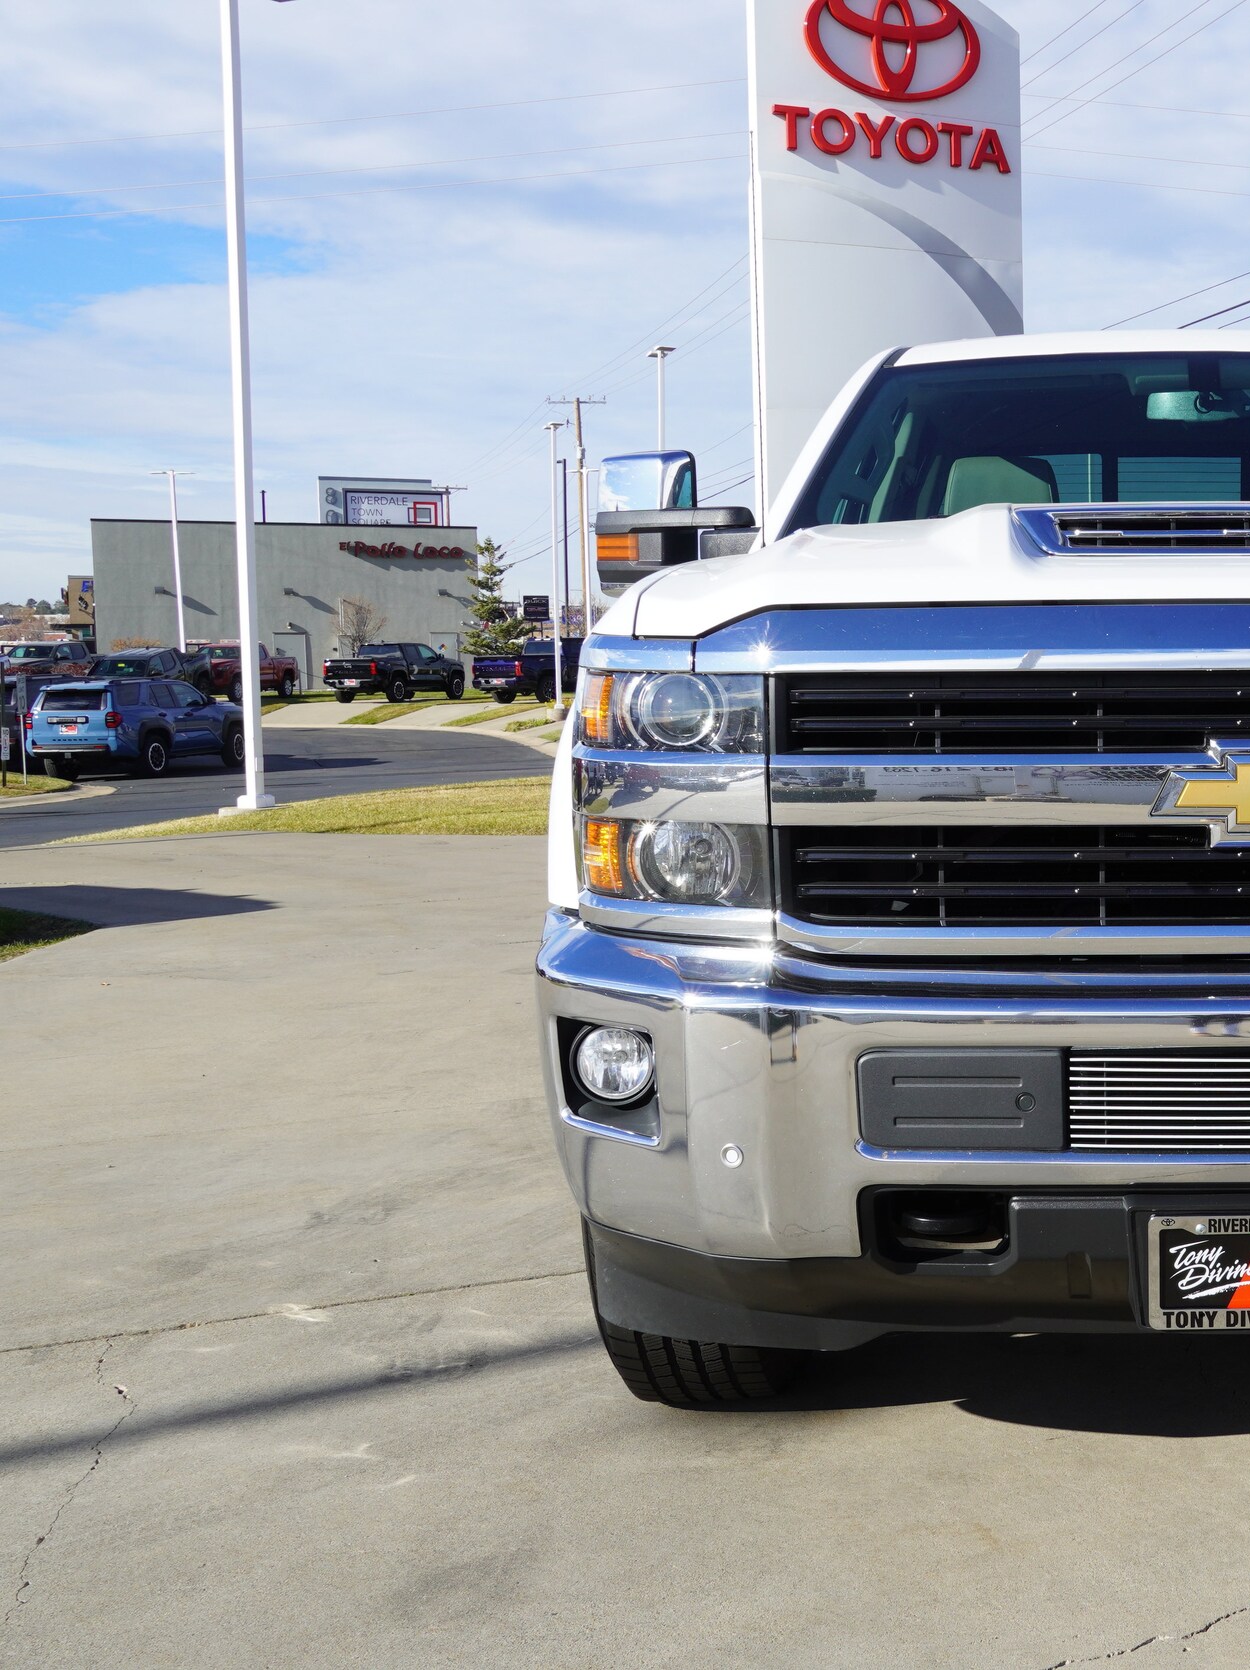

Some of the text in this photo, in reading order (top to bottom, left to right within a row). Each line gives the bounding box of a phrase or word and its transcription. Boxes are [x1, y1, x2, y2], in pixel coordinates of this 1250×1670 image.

[772, 103, 1011, 174] TOYOTA
[350, 496, 408, 506] RIVERDALE
[352, 508, 383, 516] TOWN
[339, 541, 464, 559] El Pollo Loco
[1169, 1239, 1225, 1270] Tony
[1162, 1310, 1218, 1328] TONY
